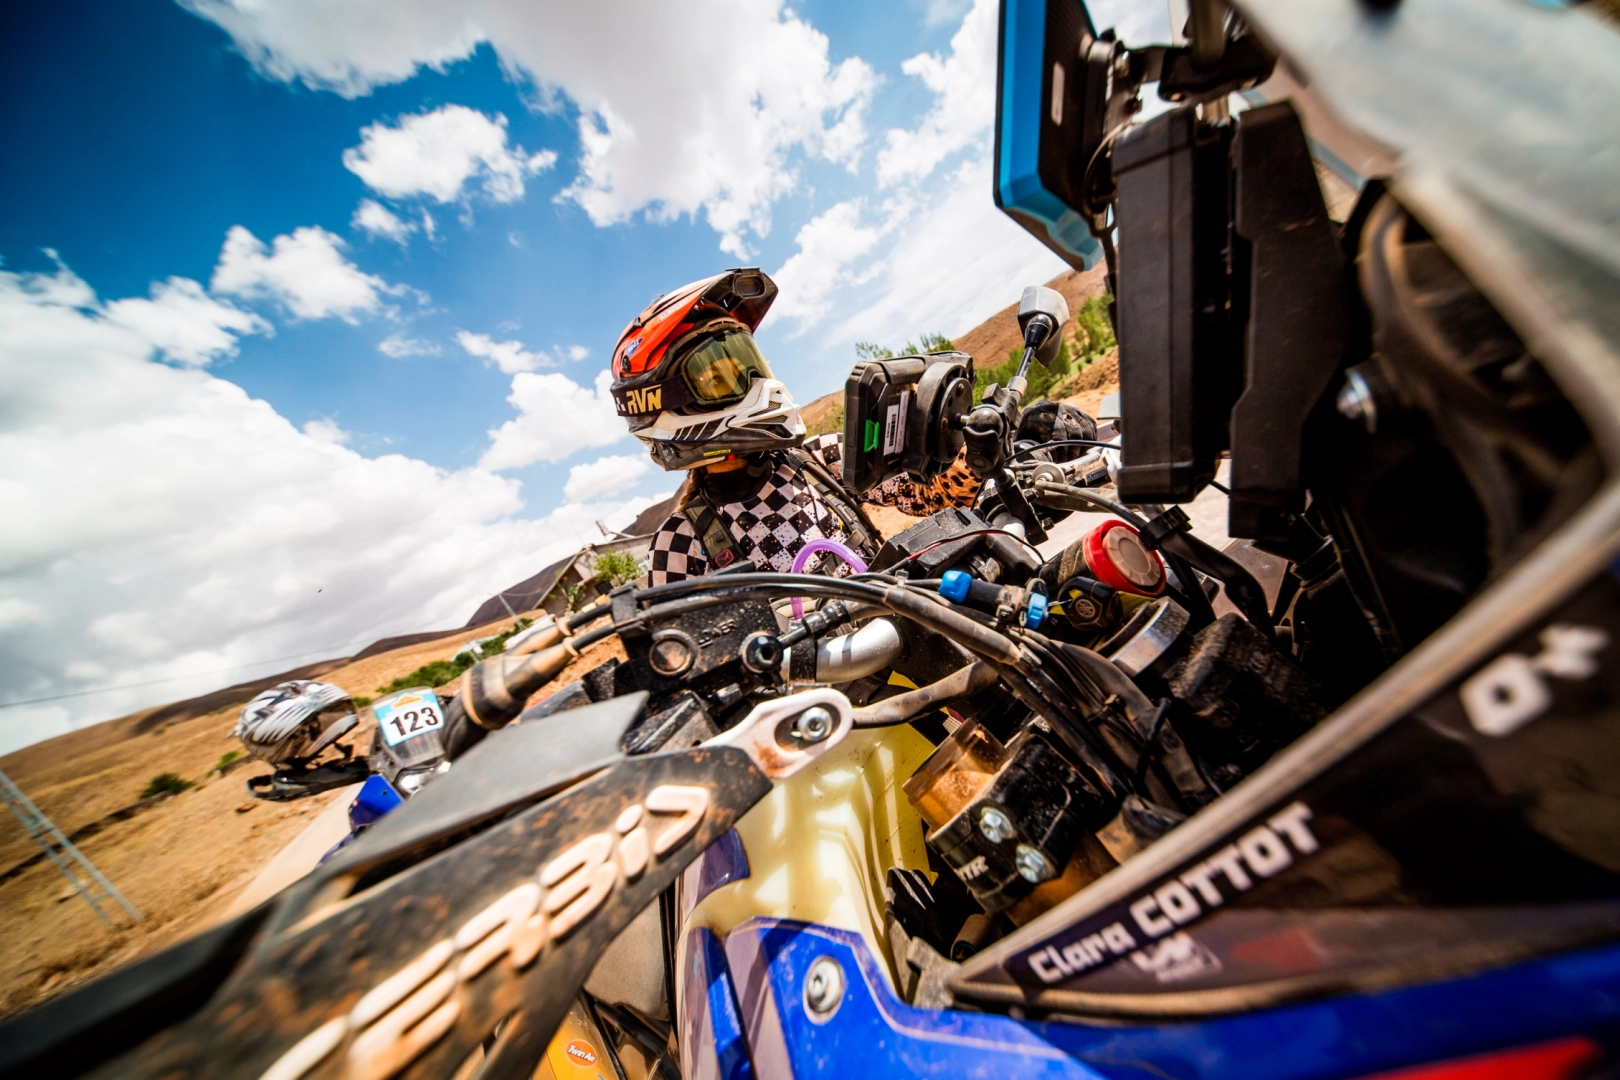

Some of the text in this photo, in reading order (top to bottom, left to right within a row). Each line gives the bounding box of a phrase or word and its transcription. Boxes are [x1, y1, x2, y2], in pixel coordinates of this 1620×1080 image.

[626, 384, 662, 415] RVN
[390, 706, 439, 737] 123
[1027, 800, 1320, 983] Clara COTTOT
[567, 1044, 597, 1062] Twin Air
